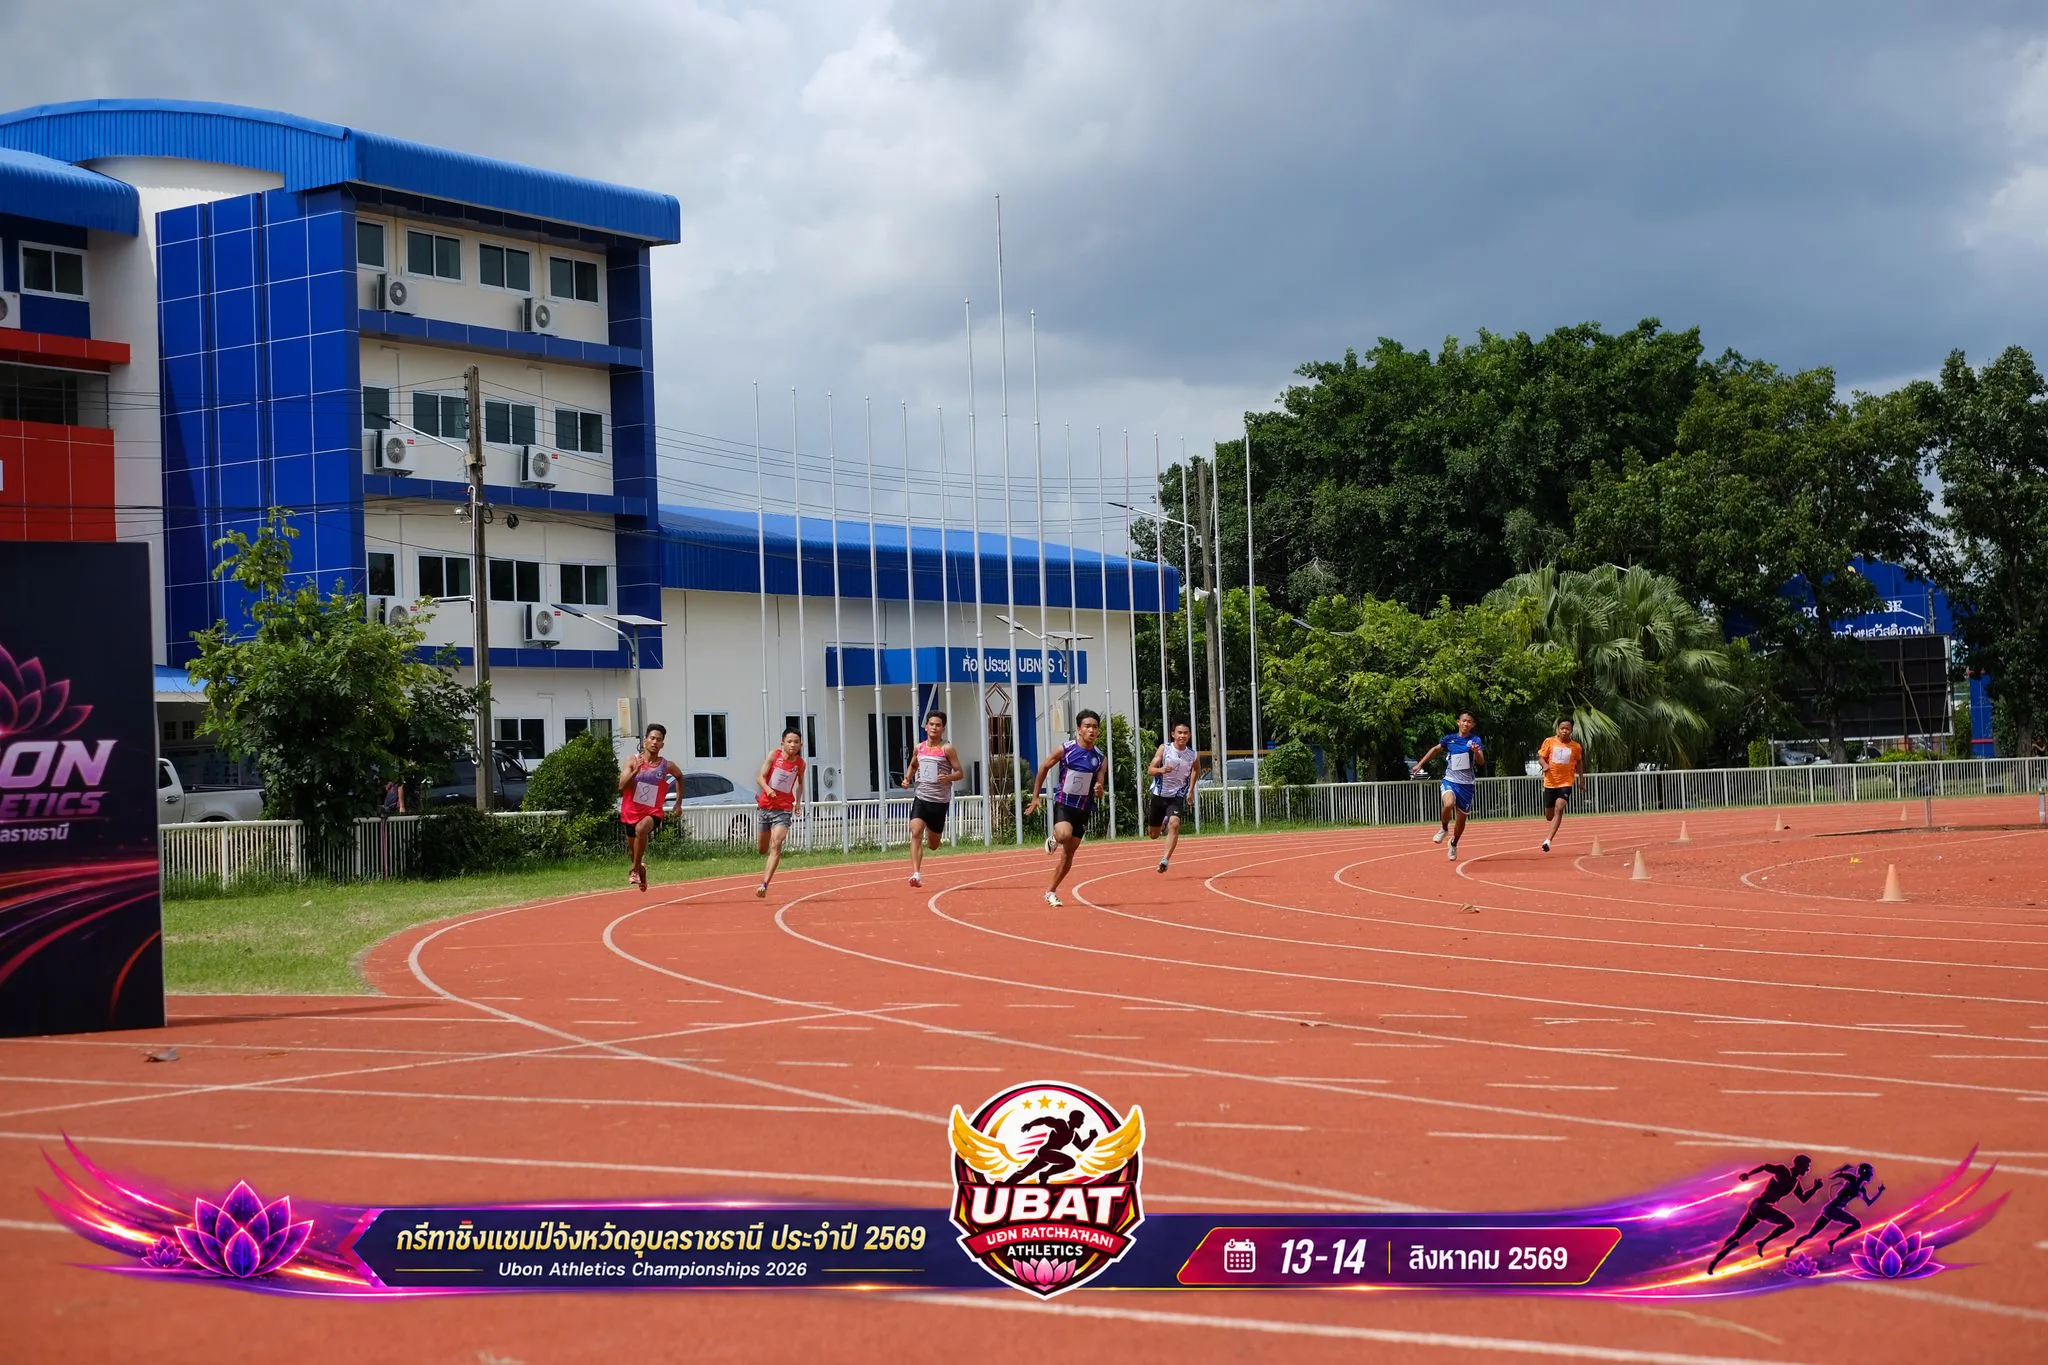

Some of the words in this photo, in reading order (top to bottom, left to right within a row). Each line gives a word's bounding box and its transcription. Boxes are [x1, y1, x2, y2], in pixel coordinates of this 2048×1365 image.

[1018, 657, 1055, 673] UBNS
[1073, 775, 1084, 794] 5
[640, 785, 650, 802] 8
